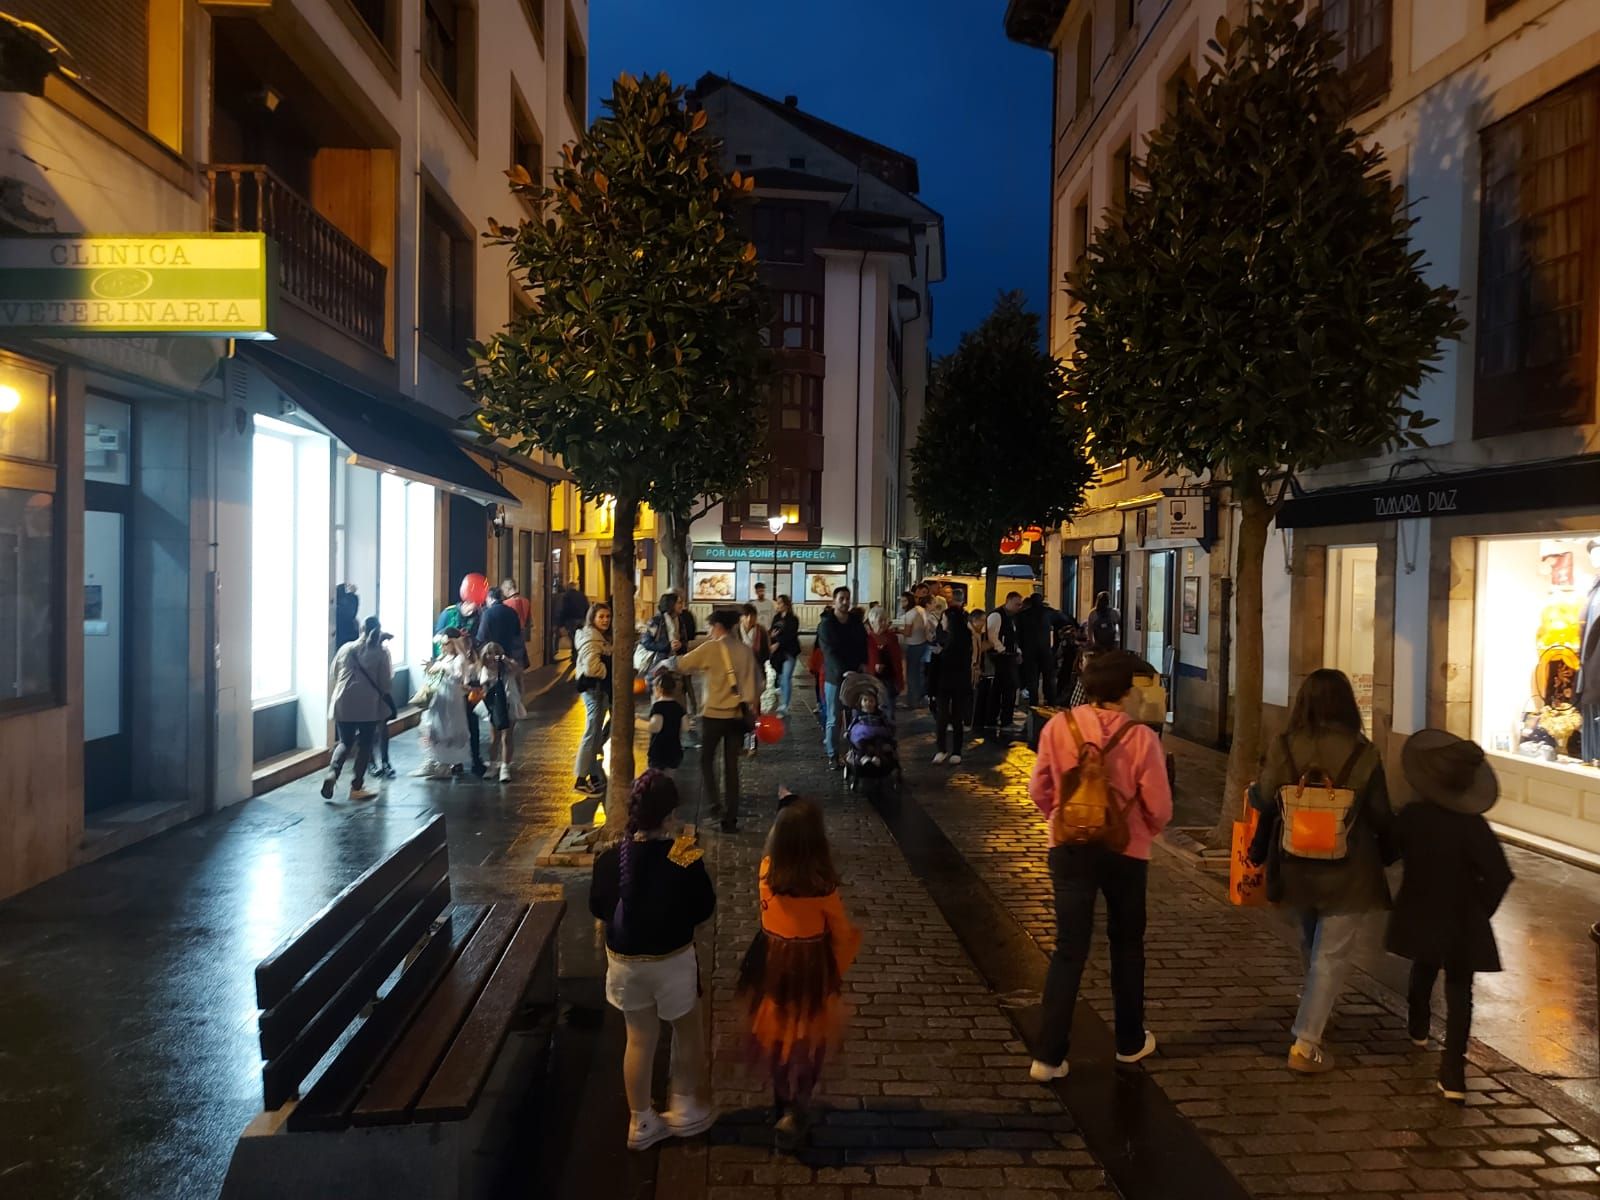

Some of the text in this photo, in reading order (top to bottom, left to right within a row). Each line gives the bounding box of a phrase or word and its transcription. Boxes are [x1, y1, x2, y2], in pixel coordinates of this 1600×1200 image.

[50, 244, 192, 266] CLINICA
[2, 302, 246, 324] VETERINARIA
[1373, 489, 1457, 516] TAMARA DIAZ
[705, 549, 837, 559] POR UNA SONRSA PERFECTA
